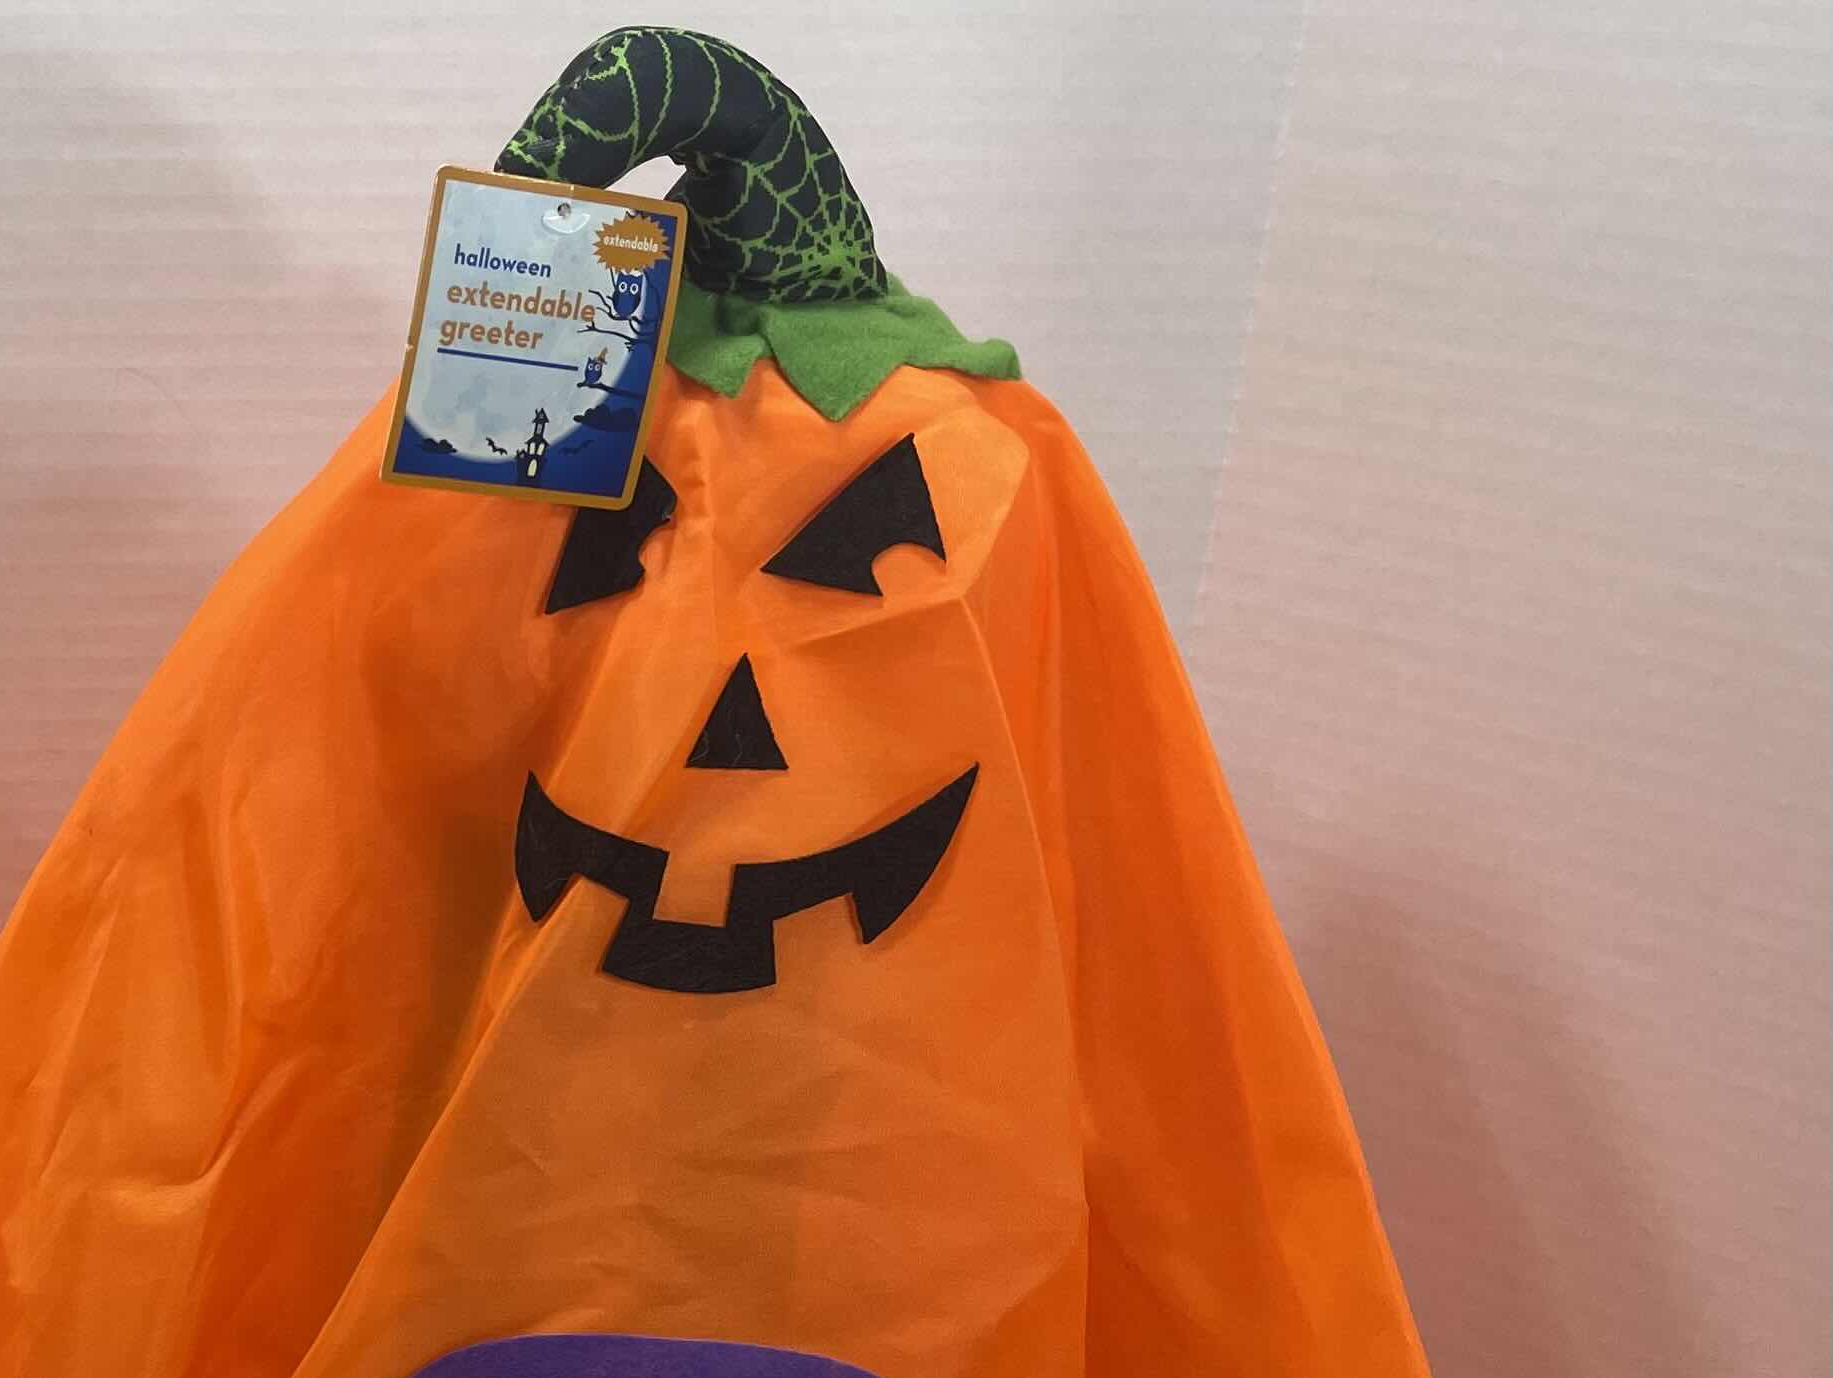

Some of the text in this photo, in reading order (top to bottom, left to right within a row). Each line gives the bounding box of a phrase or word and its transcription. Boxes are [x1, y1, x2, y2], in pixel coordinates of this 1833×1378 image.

[603, 234, 659, 253] extendable
[454, 243, 551, 278] halloween
[447, 281, 595, 321] extendable
[439, 319, 543, 349] greeter
